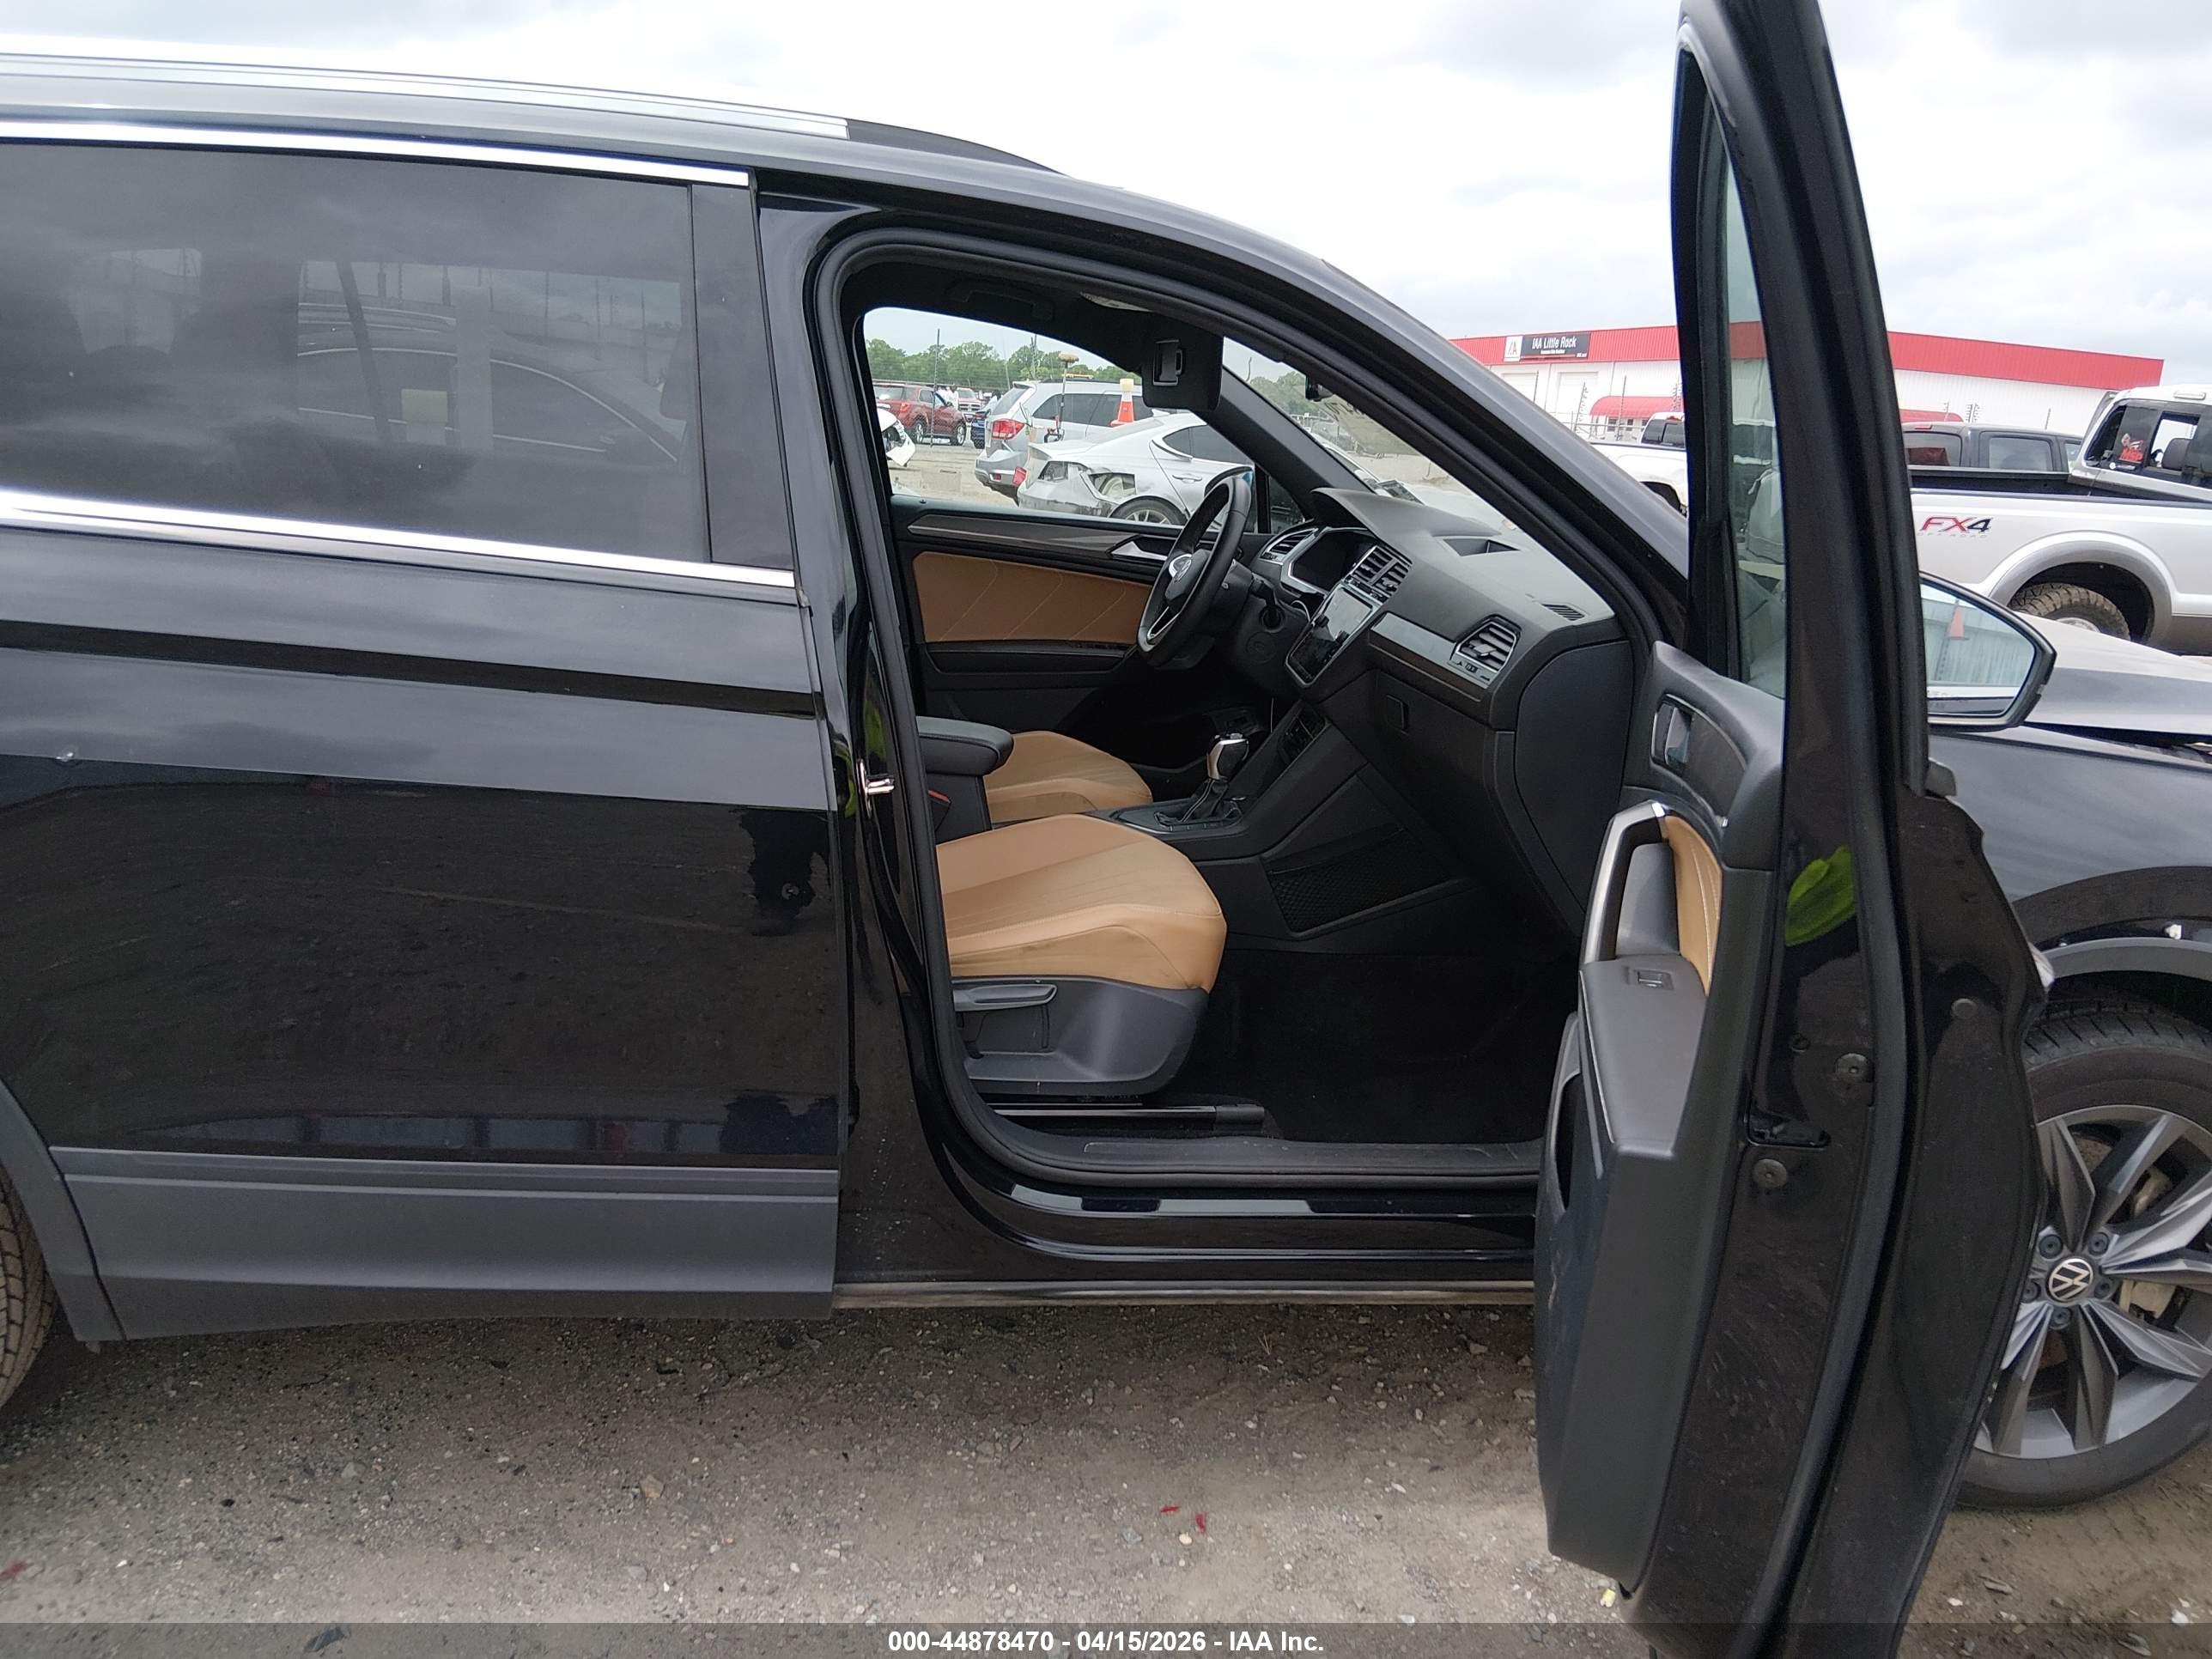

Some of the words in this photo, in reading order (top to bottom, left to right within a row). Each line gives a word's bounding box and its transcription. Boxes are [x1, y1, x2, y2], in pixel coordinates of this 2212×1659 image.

[1532, 337, 1542, 349] IAA
[1543, 337, 1559, 349] Little
[1560, 336, 1577, 349] Rock
[1919, 517, 1992, 532] FX4
